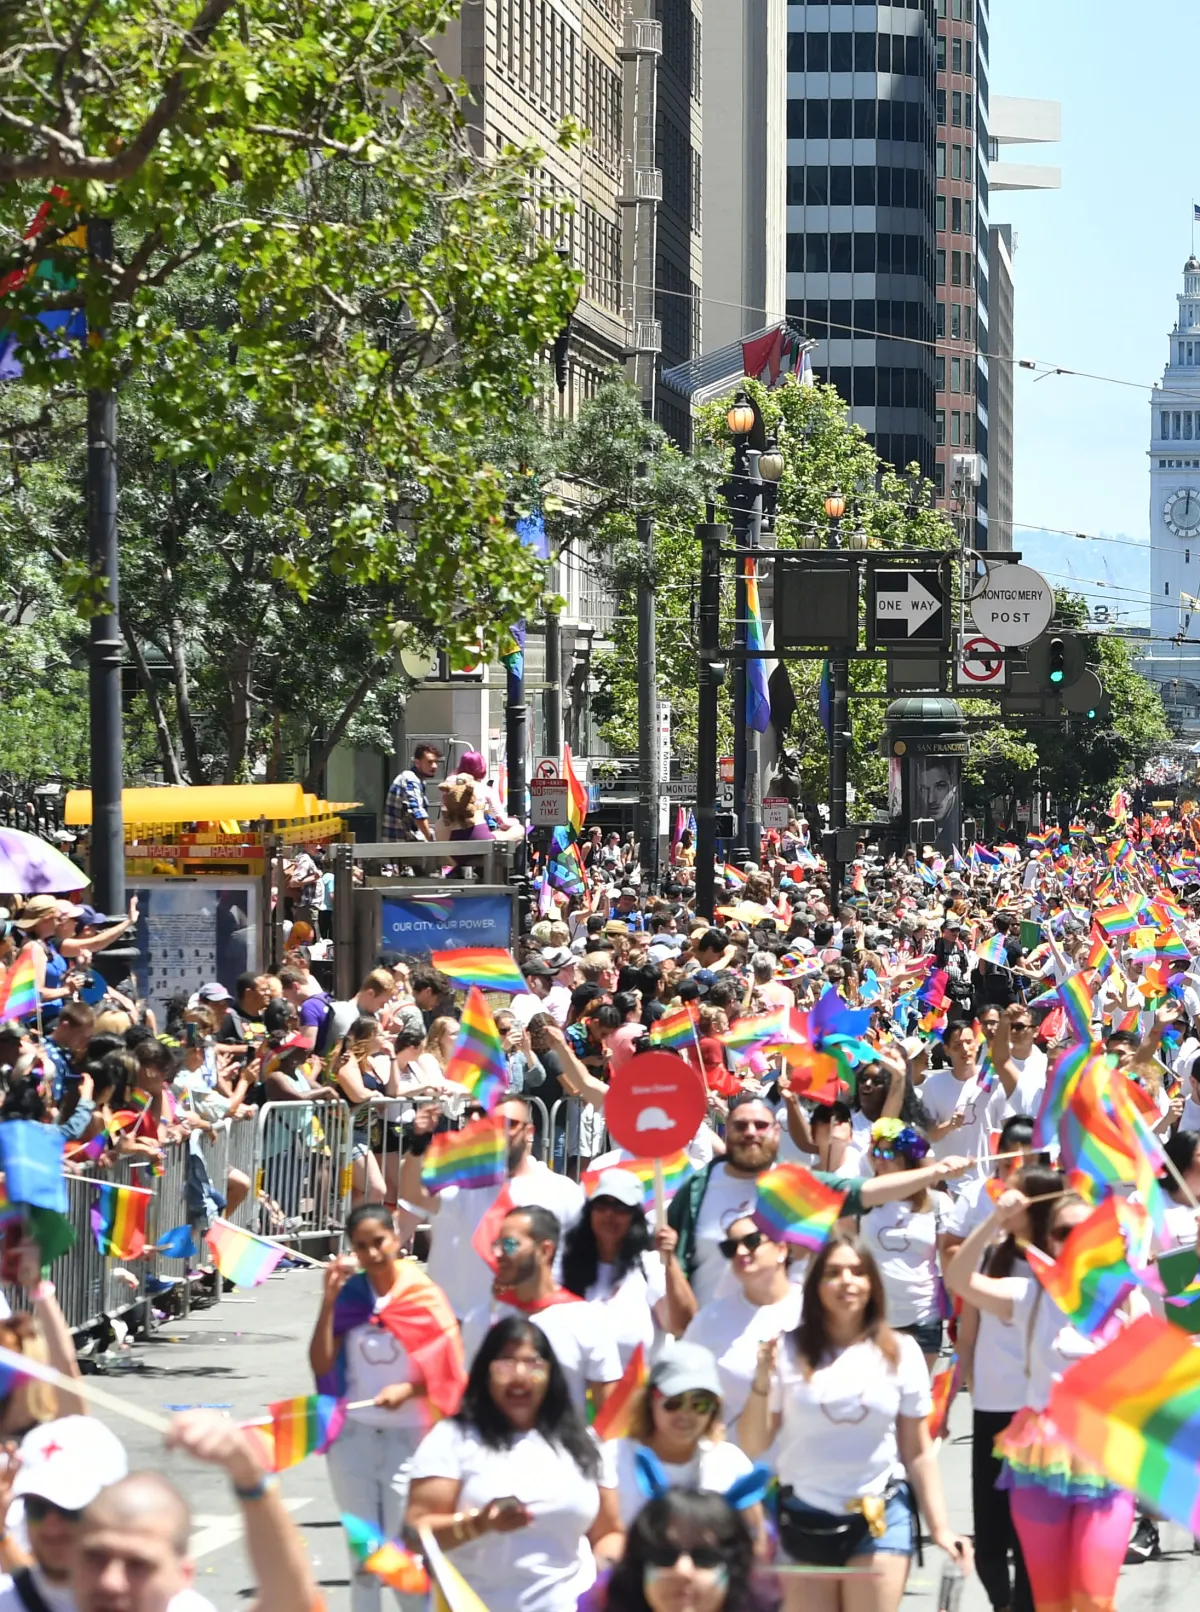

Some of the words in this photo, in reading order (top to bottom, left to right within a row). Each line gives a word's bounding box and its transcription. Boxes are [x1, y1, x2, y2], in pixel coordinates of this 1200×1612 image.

[979, 590, 1043, 601] MONTGOMERY
[878, 600, 902, 611] ONE
[910, 600, 935, 611] WAY
[991, 612, 1030, 623] POST
[532, 787, 541, 795] NO
[540, 808, 559, 816] TIME
[216, 833, 249, 844] RAPID
[148, 846, 180, 858] RAPID
[210, 846, 244, 858] RAPID
[392, 922, 412, 932] OUR
[413, 921, 435, 931] CITY.
[436, 920, 458, 930] OUR
[459, 919, 497, 929] POWER.
